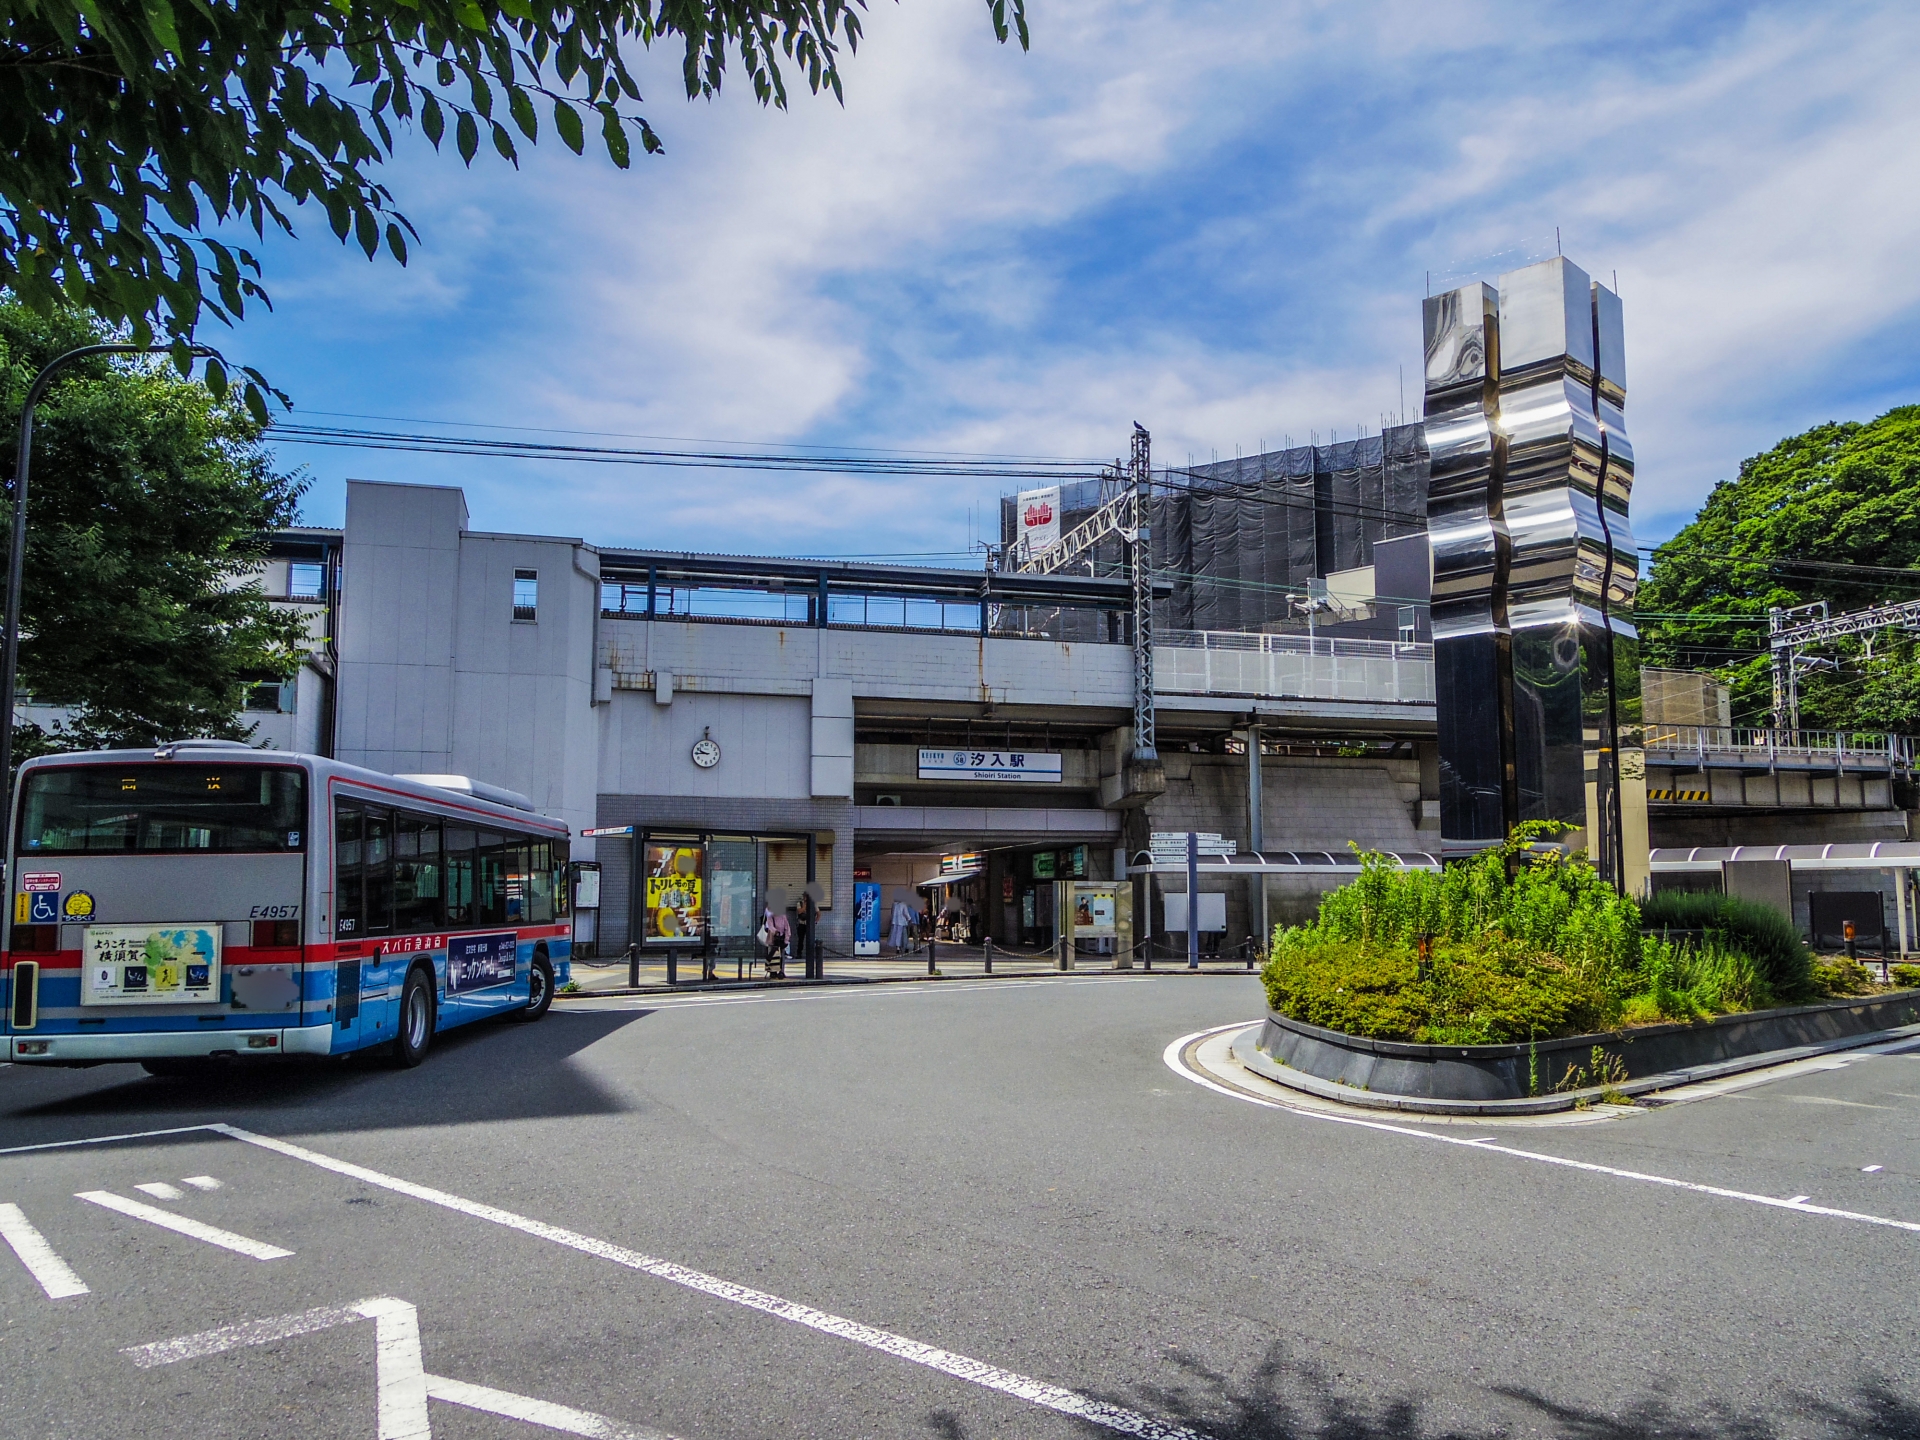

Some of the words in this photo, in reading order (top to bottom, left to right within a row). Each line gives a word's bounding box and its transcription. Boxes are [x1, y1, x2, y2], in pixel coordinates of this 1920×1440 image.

[970, 752, 1025, 768] 汐入駅
[997, 772, 1022, 780] Station
[250, 905, 299, 918] E4957
[338, 918, 356, 932] E4957
[94, 939, 127, 950] ようこそ
[99, 950, 152, 962] 横須賀へ
[461, 955, 495, 980] ニッケンホーム
